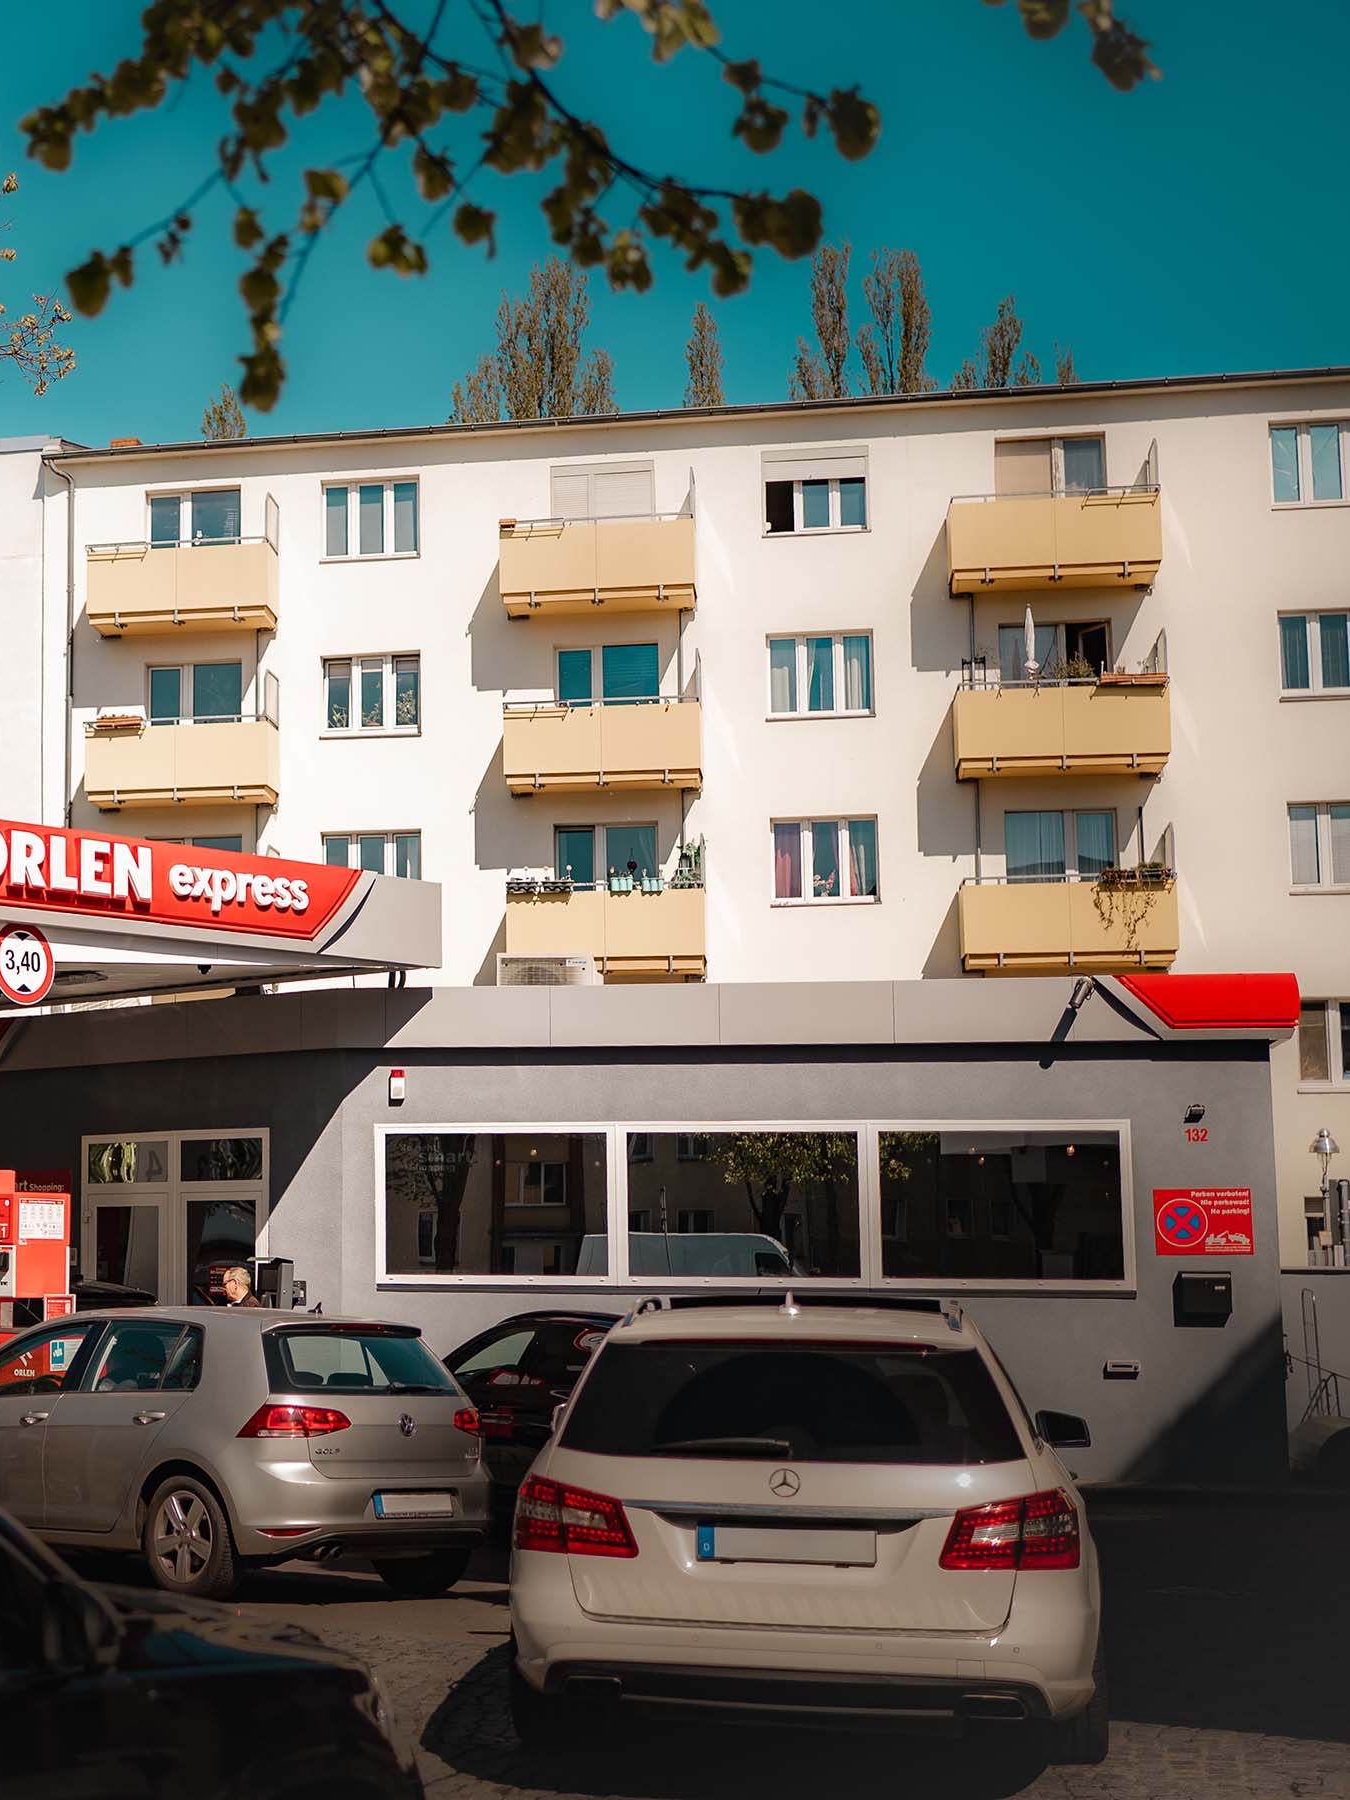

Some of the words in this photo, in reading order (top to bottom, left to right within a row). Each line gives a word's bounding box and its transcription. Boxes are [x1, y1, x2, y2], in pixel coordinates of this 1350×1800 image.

[169, 864, 310, 912] express
[5, 950, 41, 976] 3,40
[1185, 1128, 1209, 1142] 132
[13, 1368, 35, 1377] ORLEN
